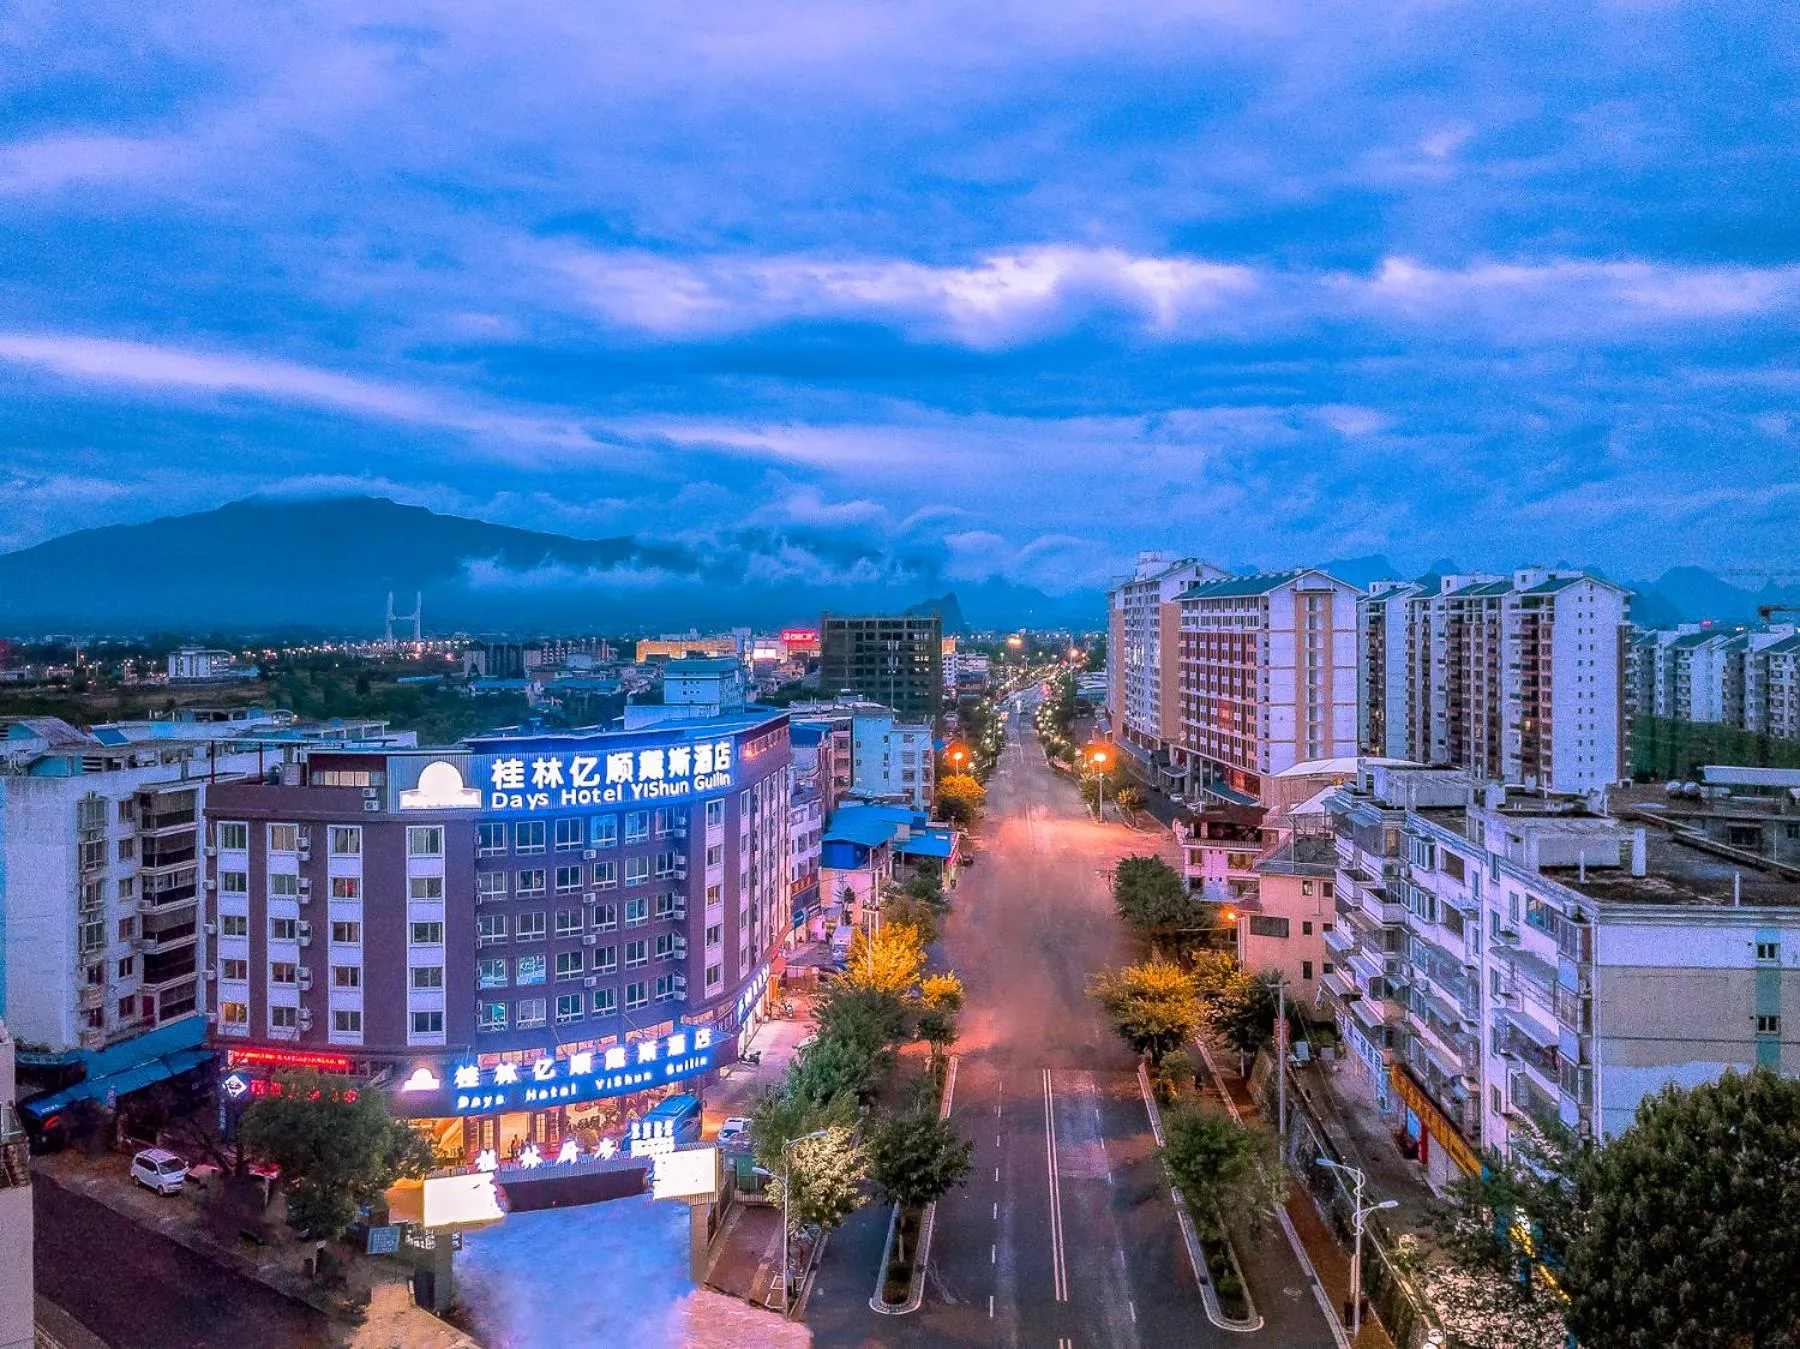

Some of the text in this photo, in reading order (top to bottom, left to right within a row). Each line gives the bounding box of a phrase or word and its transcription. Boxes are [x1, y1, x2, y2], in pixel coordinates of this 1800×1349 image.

[491, 740, 731, 791] 桂林亿顺戴斯酒店
[491, 791, 549, 811] Days
[561, 783, 623, 806] Hotel
[457, 1094, 505, 1110] Days
[525, 1082, 577, 1102] Hotel
